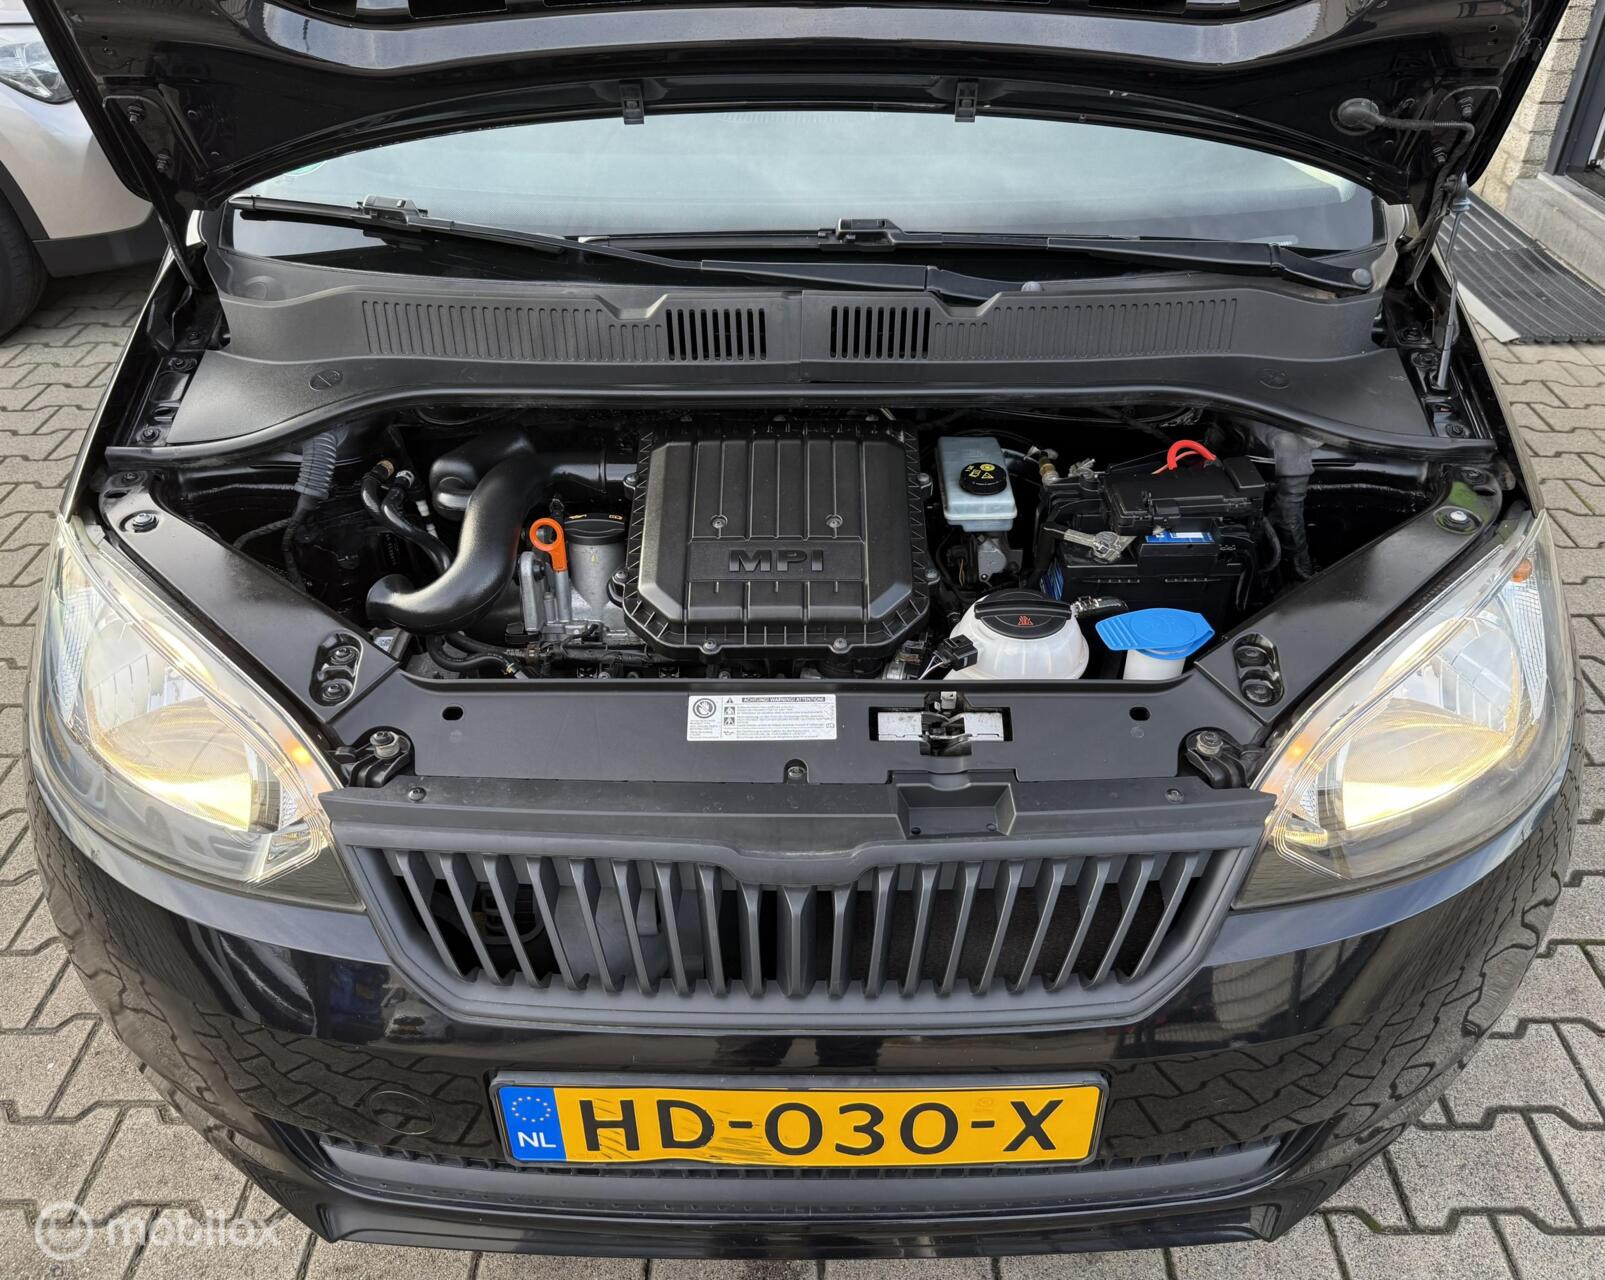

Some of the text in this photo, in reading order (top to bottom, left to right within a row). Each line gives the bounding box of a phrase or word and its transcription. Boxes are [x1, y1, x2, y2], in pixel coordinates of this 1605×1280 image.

[729, 549, 824, 572] MPI
[579, 1099, 1064, 1156] HD-030-X
[517, 1131, 557, 1148] NL
